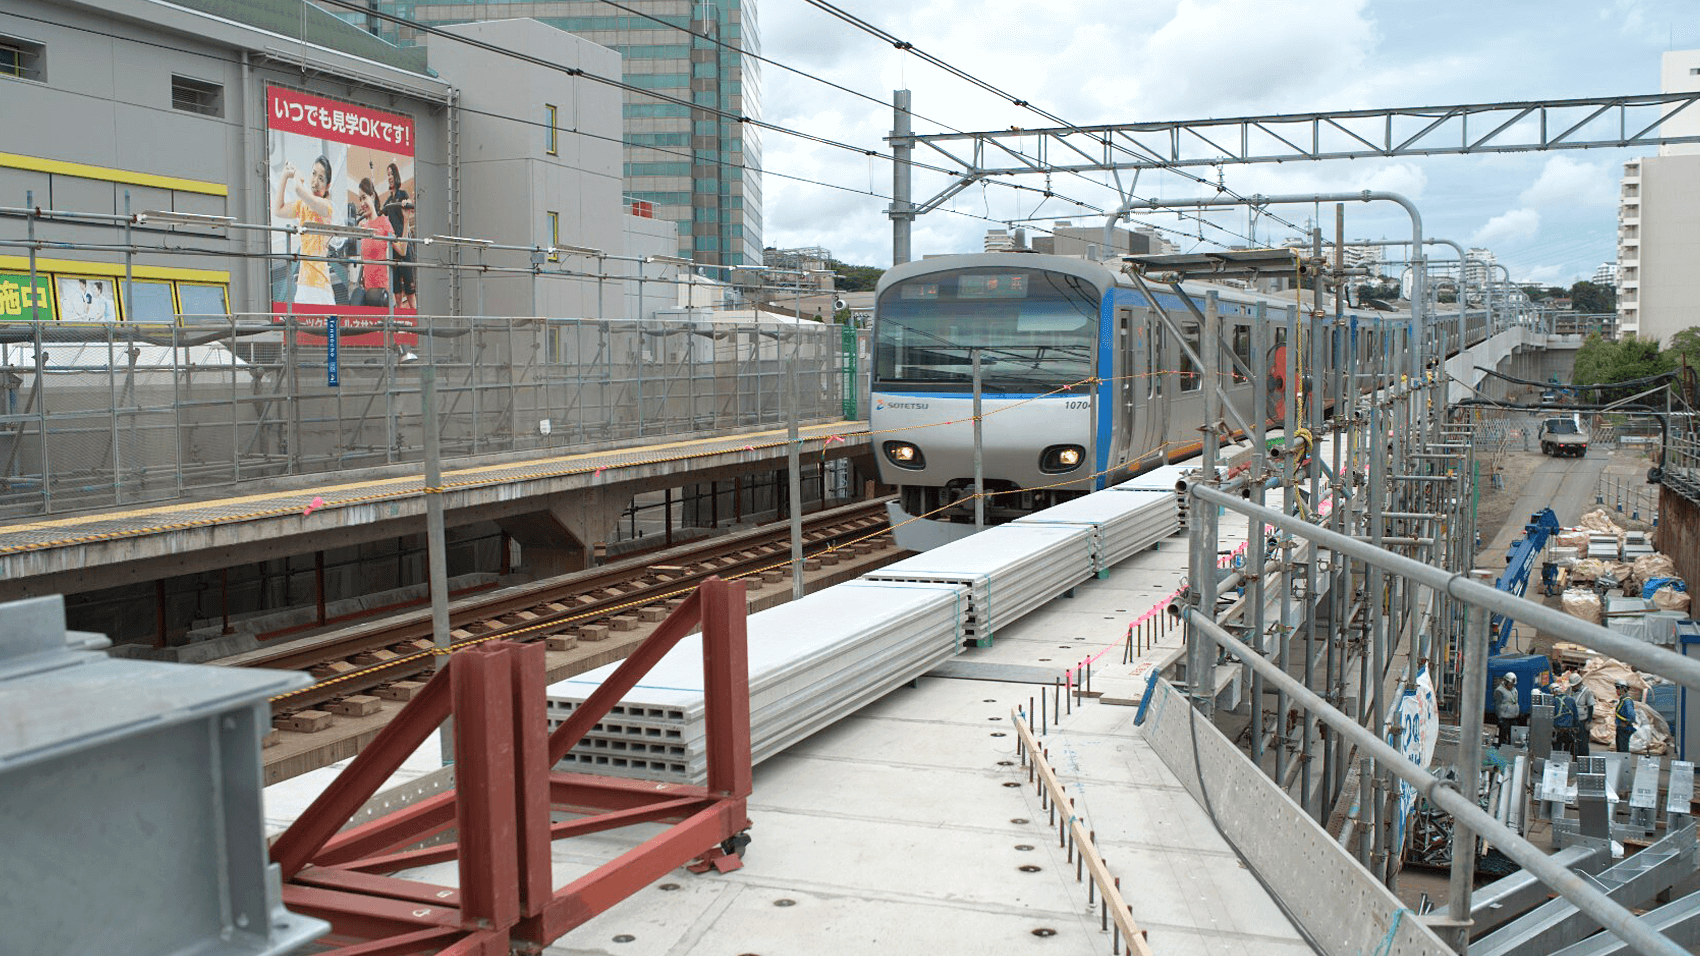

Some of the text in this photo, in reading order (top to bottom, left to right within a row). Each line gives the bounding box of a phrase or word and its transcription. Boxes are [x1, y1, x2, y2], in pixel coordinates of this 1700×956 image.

[274, 97, 410, 147] いつでも見学OKです!
[887, 402, 929, 410] SOTETSU
